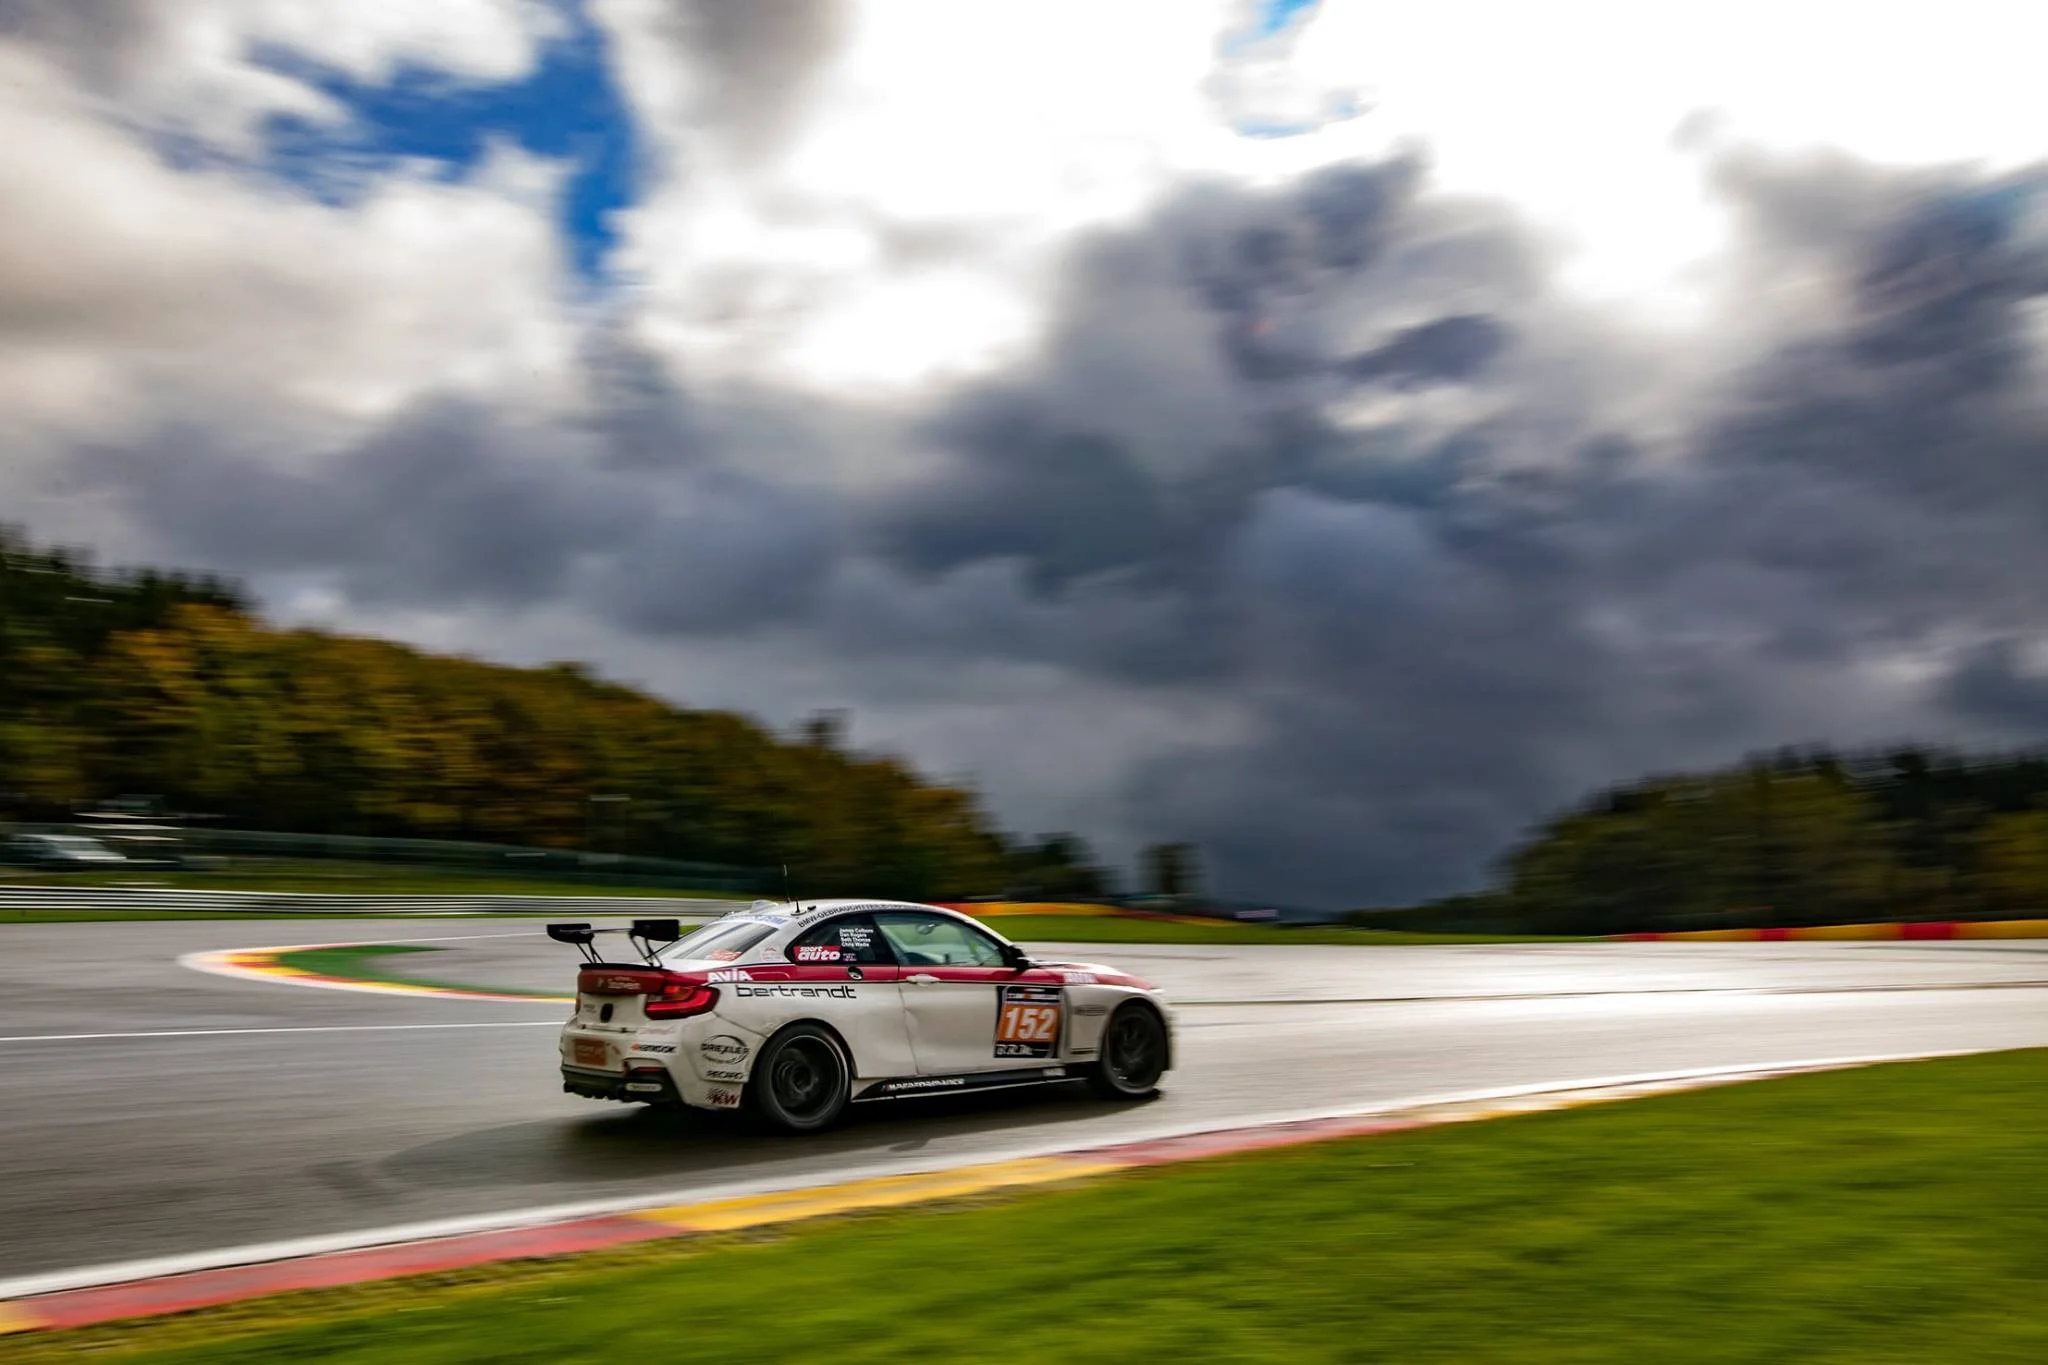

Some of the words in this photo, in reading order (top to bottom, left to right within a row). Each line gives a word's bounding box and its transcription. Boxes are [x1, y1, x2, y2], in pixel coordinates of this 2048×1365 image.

[797, 950, 841, 960] auto
[707, 968, 752, 983] AVIA
[736, 984, 858, 999] bertrandt
[1004, 1007, 1056, 1039] 152
[712, 1094, 740, 1105] KW
